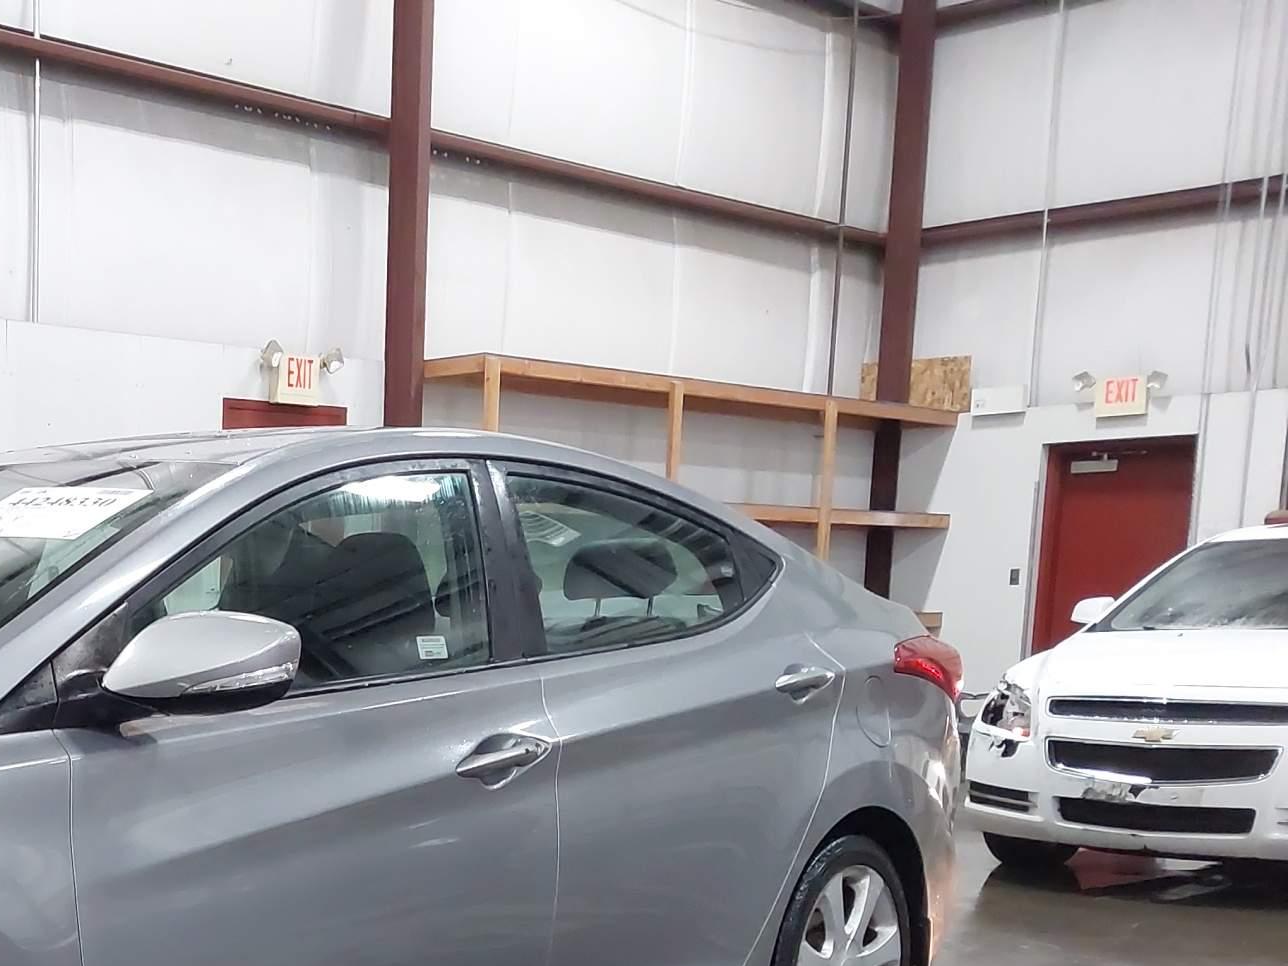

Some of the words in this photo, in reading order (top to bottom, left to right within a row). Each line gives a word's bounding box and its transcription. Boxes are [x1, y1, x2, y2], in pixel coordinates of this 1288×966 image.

[287, 357, 314, 389] EXIT
[1105, 378, 1139, 404] EXIT
[9, 496, 118, 508] 44248330
